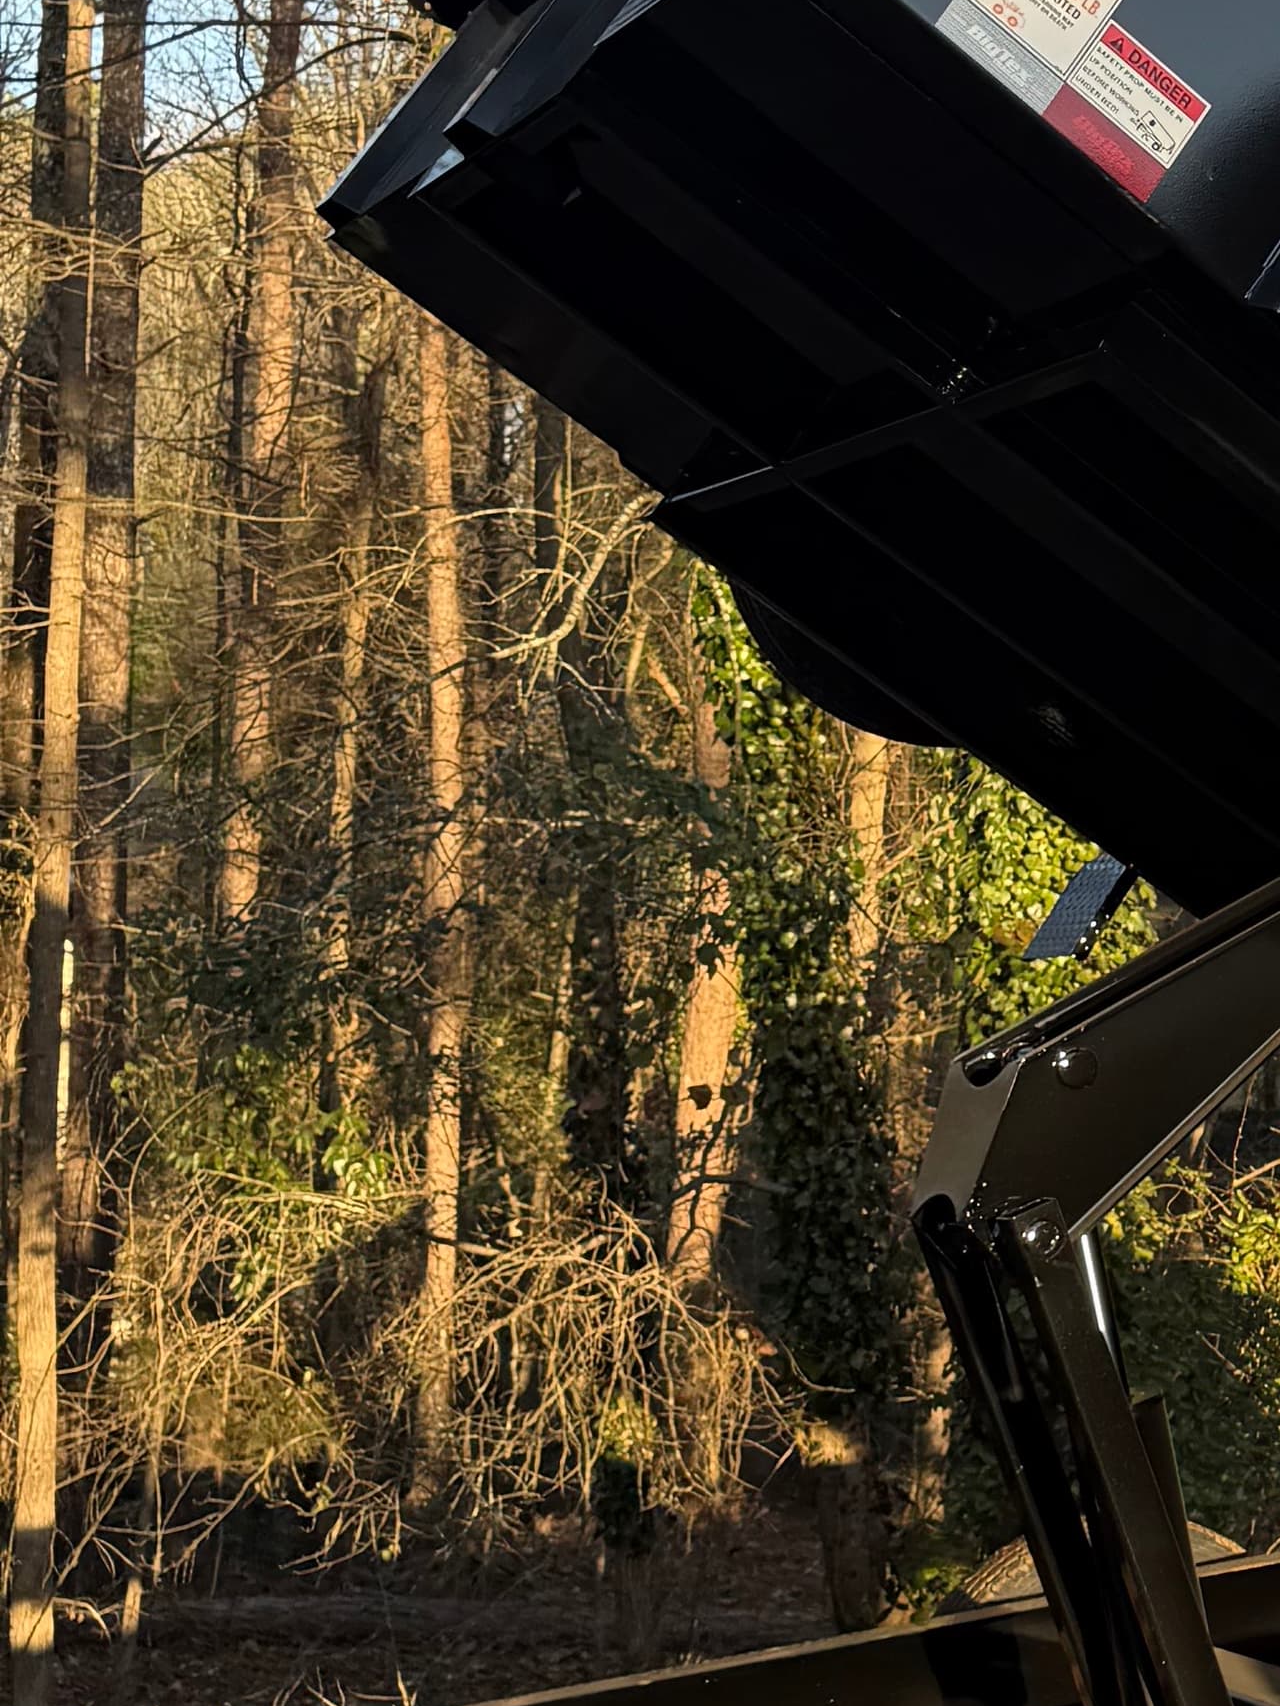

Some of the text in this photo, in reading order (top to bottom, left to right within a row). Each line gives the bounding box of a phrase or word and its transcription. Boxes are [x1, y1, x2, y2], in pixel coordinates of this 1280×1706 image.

[1082, 65, 1139, 117] BEFORE WORKING
[1089, 55, 1133, 95] UP POSITION
[1097, 46, 1124, 71] SAFETY
[1124, 70, 1144, 87] PROP
[1145, 88, 1164, 106] MUST
[1165, 105, 1175, 115] BE
[1128, 49, 1192, 109] DANGER
